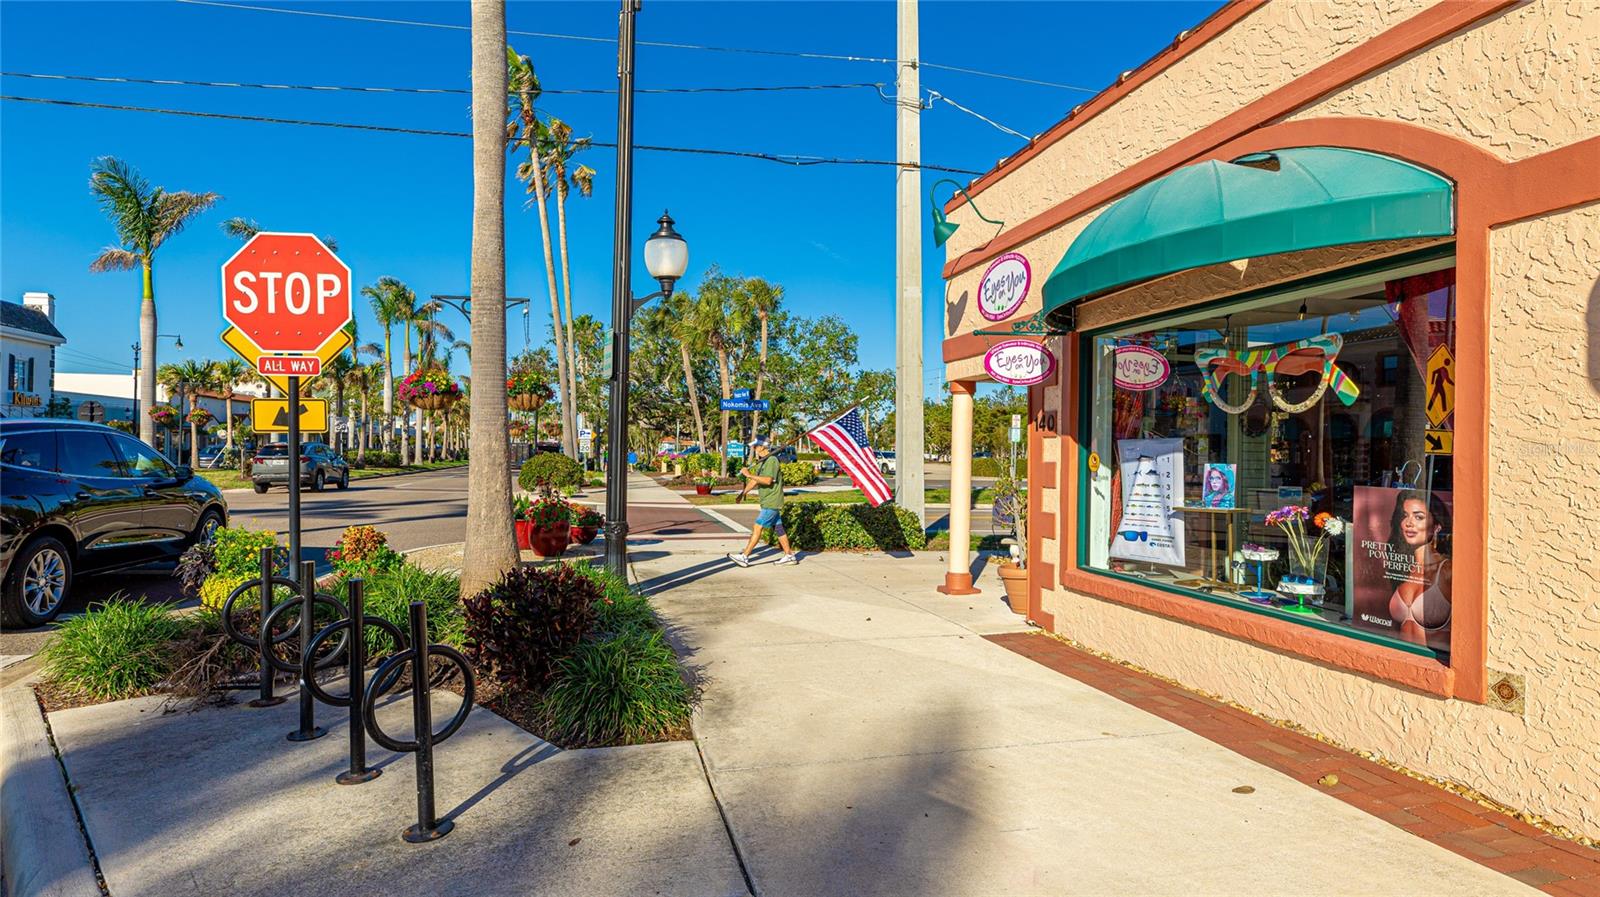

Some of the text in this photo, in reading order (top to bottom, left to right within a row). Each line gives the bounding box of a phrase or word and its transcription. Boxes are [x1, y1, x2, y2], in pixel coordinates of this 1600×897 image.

[233, 270, 342, 315] STOP
[984, 271, 1026, 304] Eyes on You
[264, 360, 315, 372] ALL WAY
[995, 351, 1024, 371] Eyes
[1023, 354, 1047, 374] You
[722, 401, 749, 409] Nokomis
[1033, 414, 1055, 432] 140
[1369, 615, 1393, 627] Wacoal
